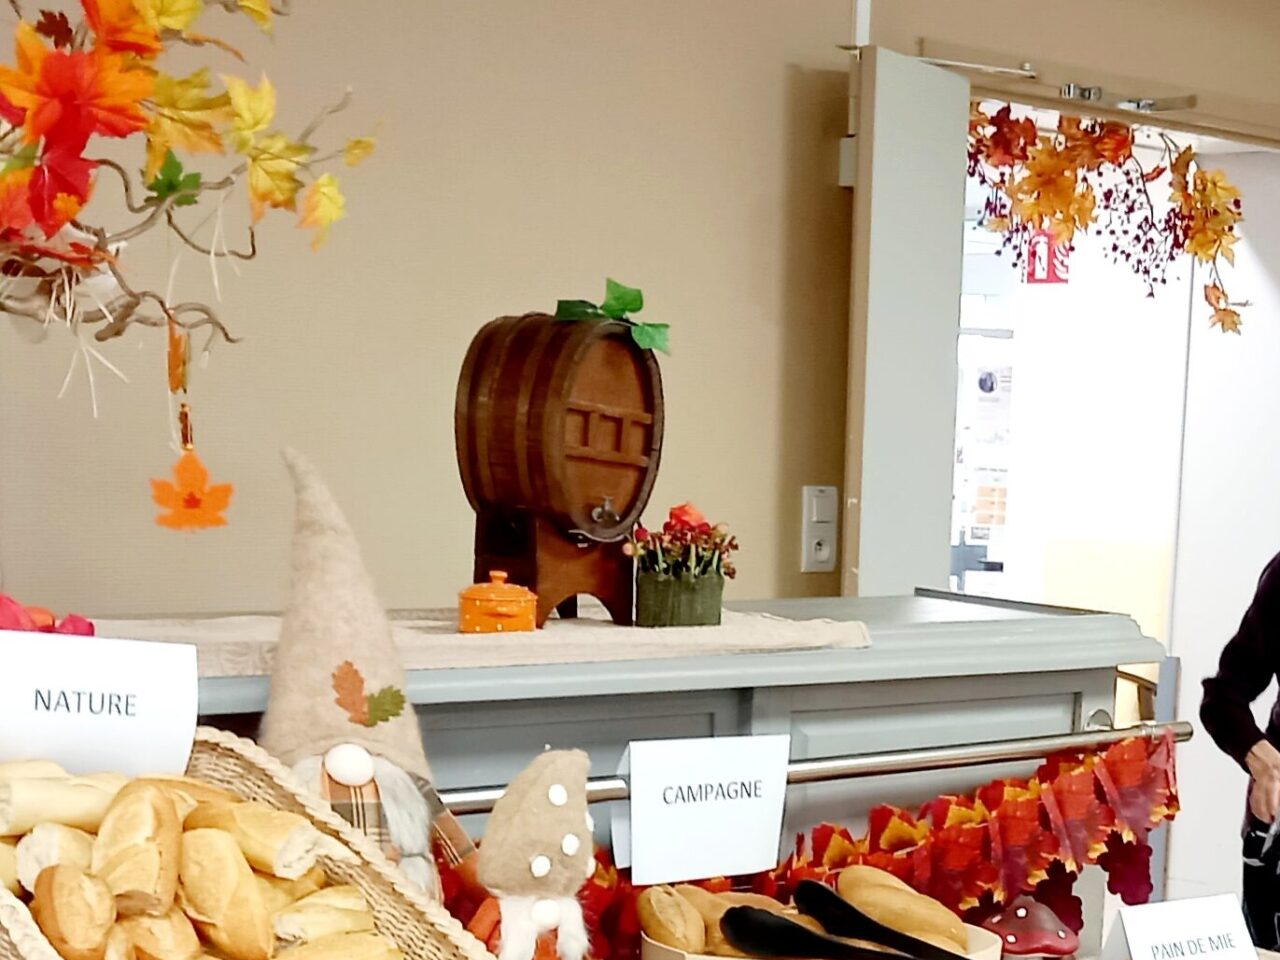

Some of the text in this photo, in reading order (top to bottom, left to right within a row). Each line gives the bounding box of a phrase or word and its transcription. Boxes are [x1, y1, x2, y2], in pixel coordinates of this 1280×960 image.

[34, 688, 137, 717] NATURE
[662, 779, 763, 805] CAMPAGNE
[1151, 933, 1237, 960] PAIN DE MIE
